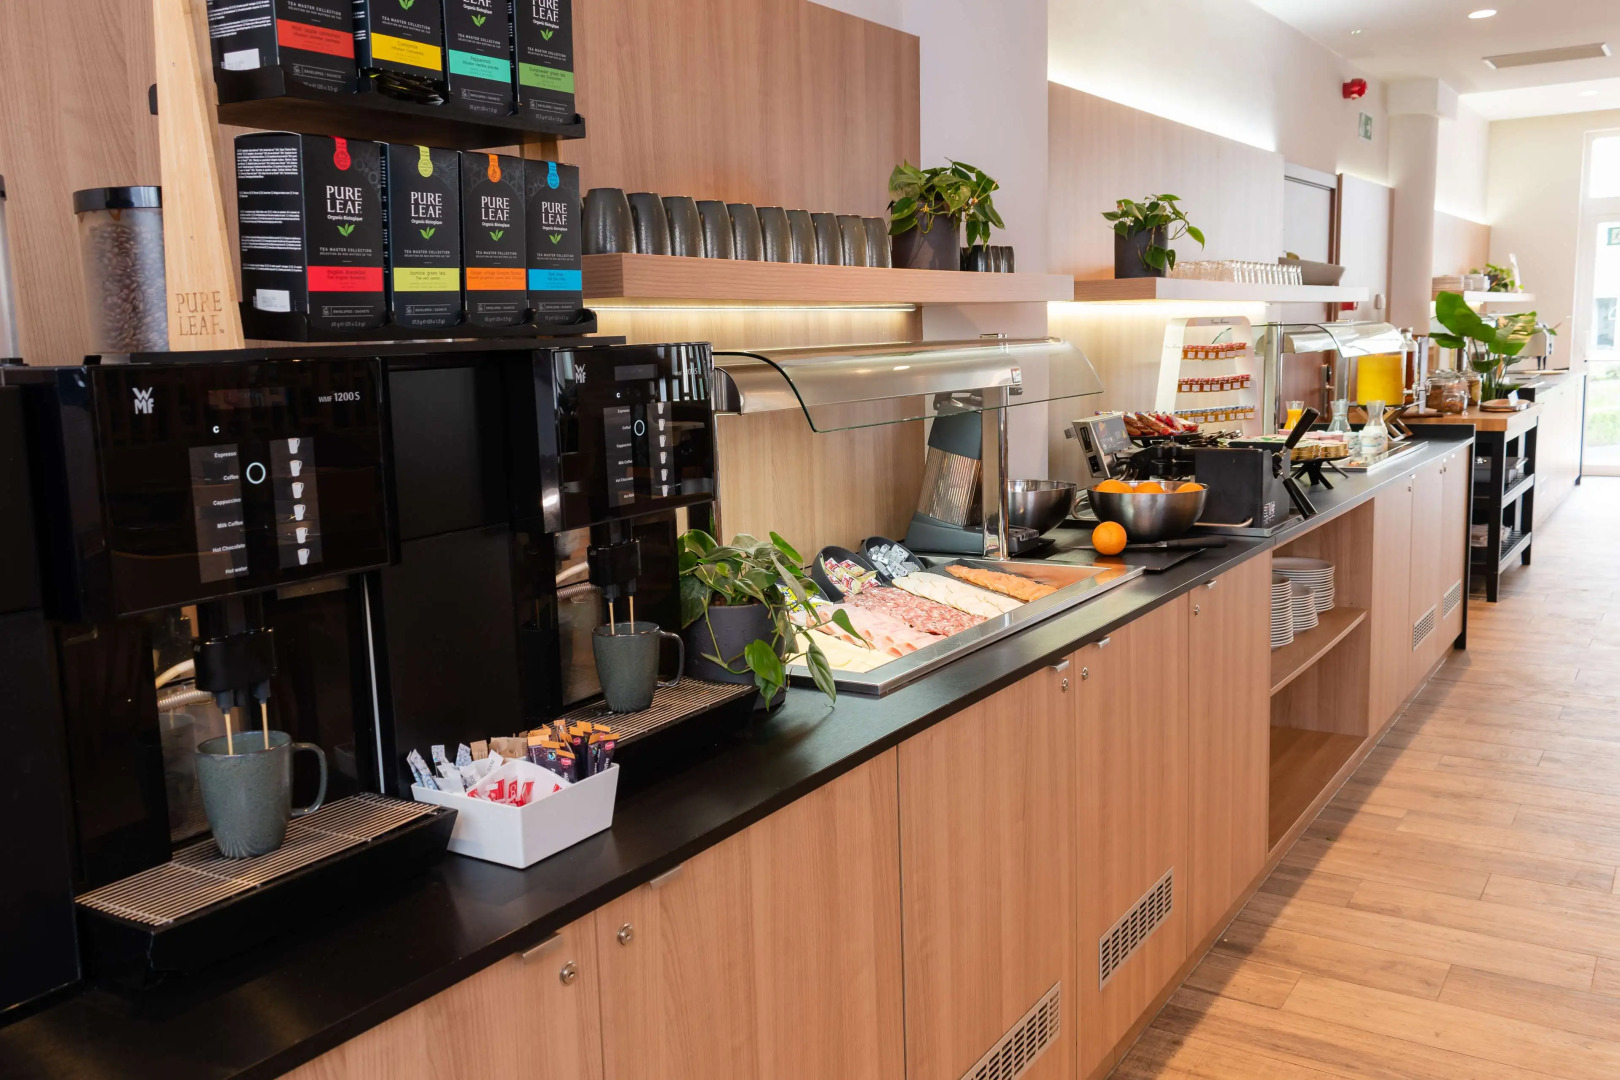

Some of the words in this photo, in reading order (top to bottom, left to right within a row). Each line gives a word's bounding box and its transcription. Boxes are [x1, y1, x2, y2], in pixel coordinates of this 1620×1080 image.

[316, 6, 342, 16] COLLECTION
[532, 6, 559, 22] LEAF
[408, 21, 431, 30] COLLECTION
[326, 186, 362, 200] PURE
[410, 191, 442, 206] PURE
[327, 199, 362, 214] LEAF
[481, 196, 510, 209] PURE
[542, 202, 567, 214] PURE
[411, 204, 442, 218] LEAF
[482, 208, 510, 221] LEAF
[542, 213, 567, 225] LEAF
[176, 291, 222, 313] PURE
[179, 315, 220, 336] LEAF
[574, 364, 586, 384] WMF
[132, 387, 154, 414] WMF
[213, 498, 241, 506] Cappuccino
[222, 543, 246, 552] Chocolate
